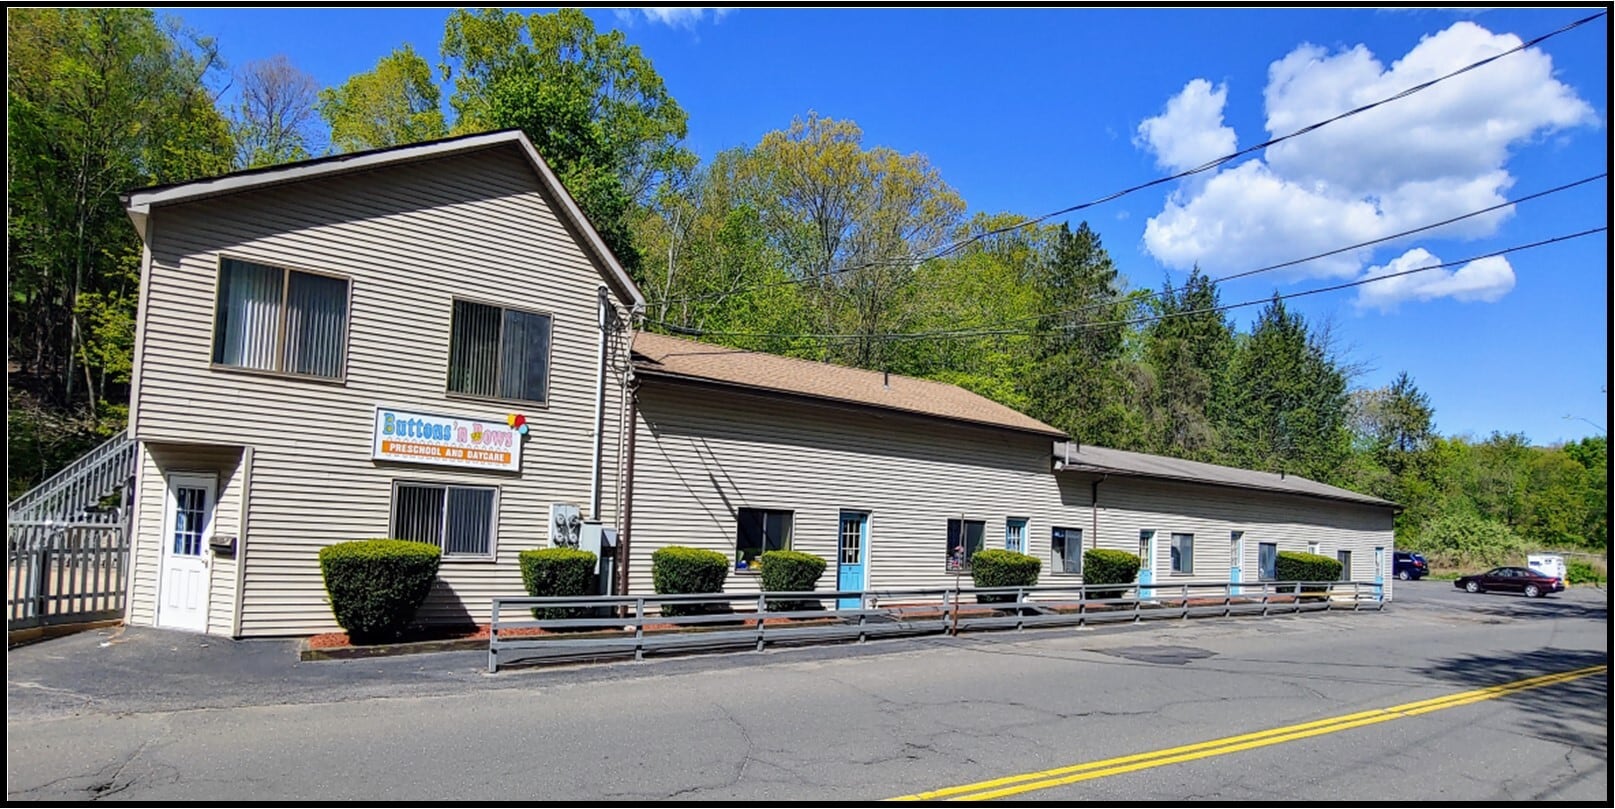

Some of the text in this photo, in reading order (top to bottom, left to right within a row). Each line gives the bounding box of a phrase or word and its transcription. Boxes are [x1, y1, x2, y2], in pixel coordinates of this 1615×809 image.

[383, 412, 513, 447] Buttons 'n Bows
[389, 443, 505, 462] PRESCHOOL AND DAYCARE
